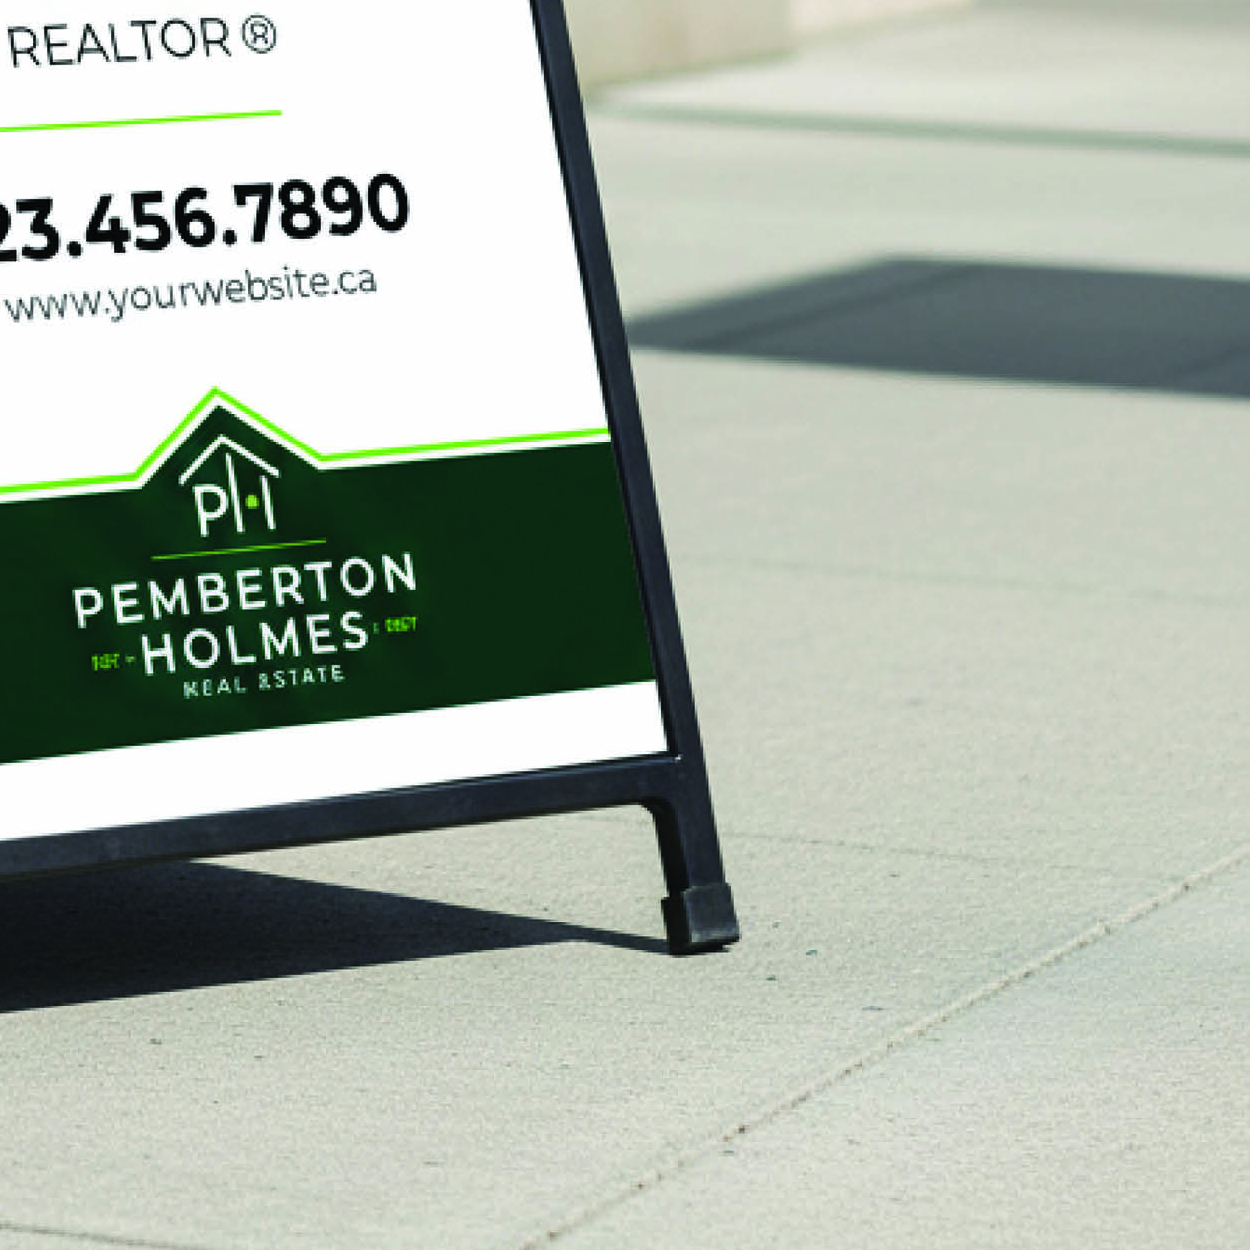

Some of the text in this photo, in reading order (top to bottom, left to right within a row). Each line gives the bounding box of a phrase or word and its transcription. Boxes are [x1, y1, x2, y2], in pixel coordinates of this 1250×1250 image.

[6, 16, 232, 69] REALTOR
[4, 265, 378, 323] www.yourwebsite.ca
[73, 552, 418, 629] PEMBERTON
[141, 610, 370, 676] HOLMES
